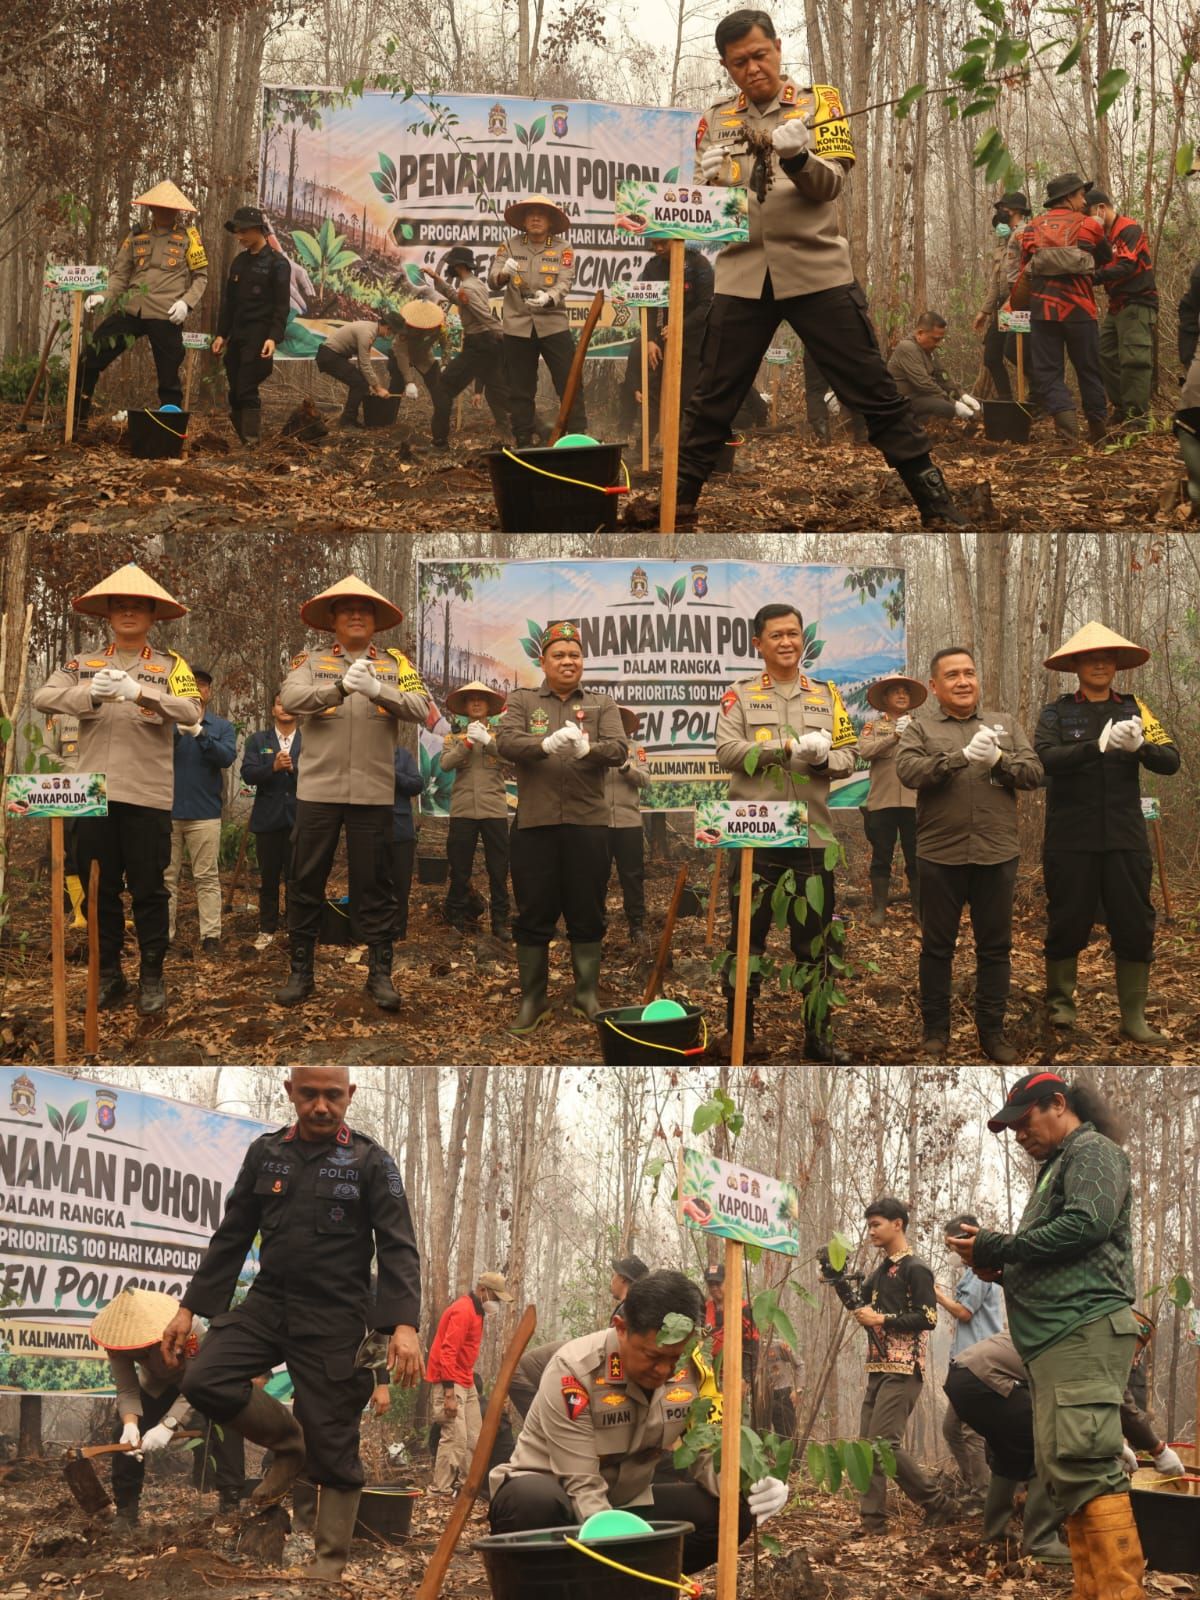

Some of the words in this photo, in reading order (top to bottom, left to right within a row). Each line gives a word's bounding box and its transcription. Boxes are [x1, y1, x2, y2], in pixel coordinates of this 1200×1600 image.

[399, 152, 571, 201] PENANAMAN
[655, 207, 712, 223] KAPOLDA
[420, 225, 480, 241] PROGRAM
[568, 229, 595, 244] HARI
[58, 275, 95, 283] KAROLOG
[547, 614, 712, 658] NANAMAN
[624, 660, 666, 674] DALAM
[671, 660, 721, 675] RANGKA
[138, 673, 168, 684] POLRI
[627, 685, 686, 700] PRIORITAS
[689, 685, 707, 700] 100
[804, 705, 829, 713] POLRI
[28, 793, 87, 804] WAKAPOLDA
[728, 822, 776, 833] KAPOLDA
[319, 1168, 359, 1181] POLRI
[122, 1157, 222, 1232] POHON
[60, 1202, 126, 1229] RANGKA
[718, 1193, 769, 1226] KAPOLDA
[81, 1238, 106, 1259] 100
[108, 1241, 142, 1264] HARI
[144, 1246, 201, 1272] KAPOLRI
[19, 1329, 99, 1351] KALIMANTAN
[602, 1410, 631, 1426] IWAN
[666, 1406, 690, 1420] POL
